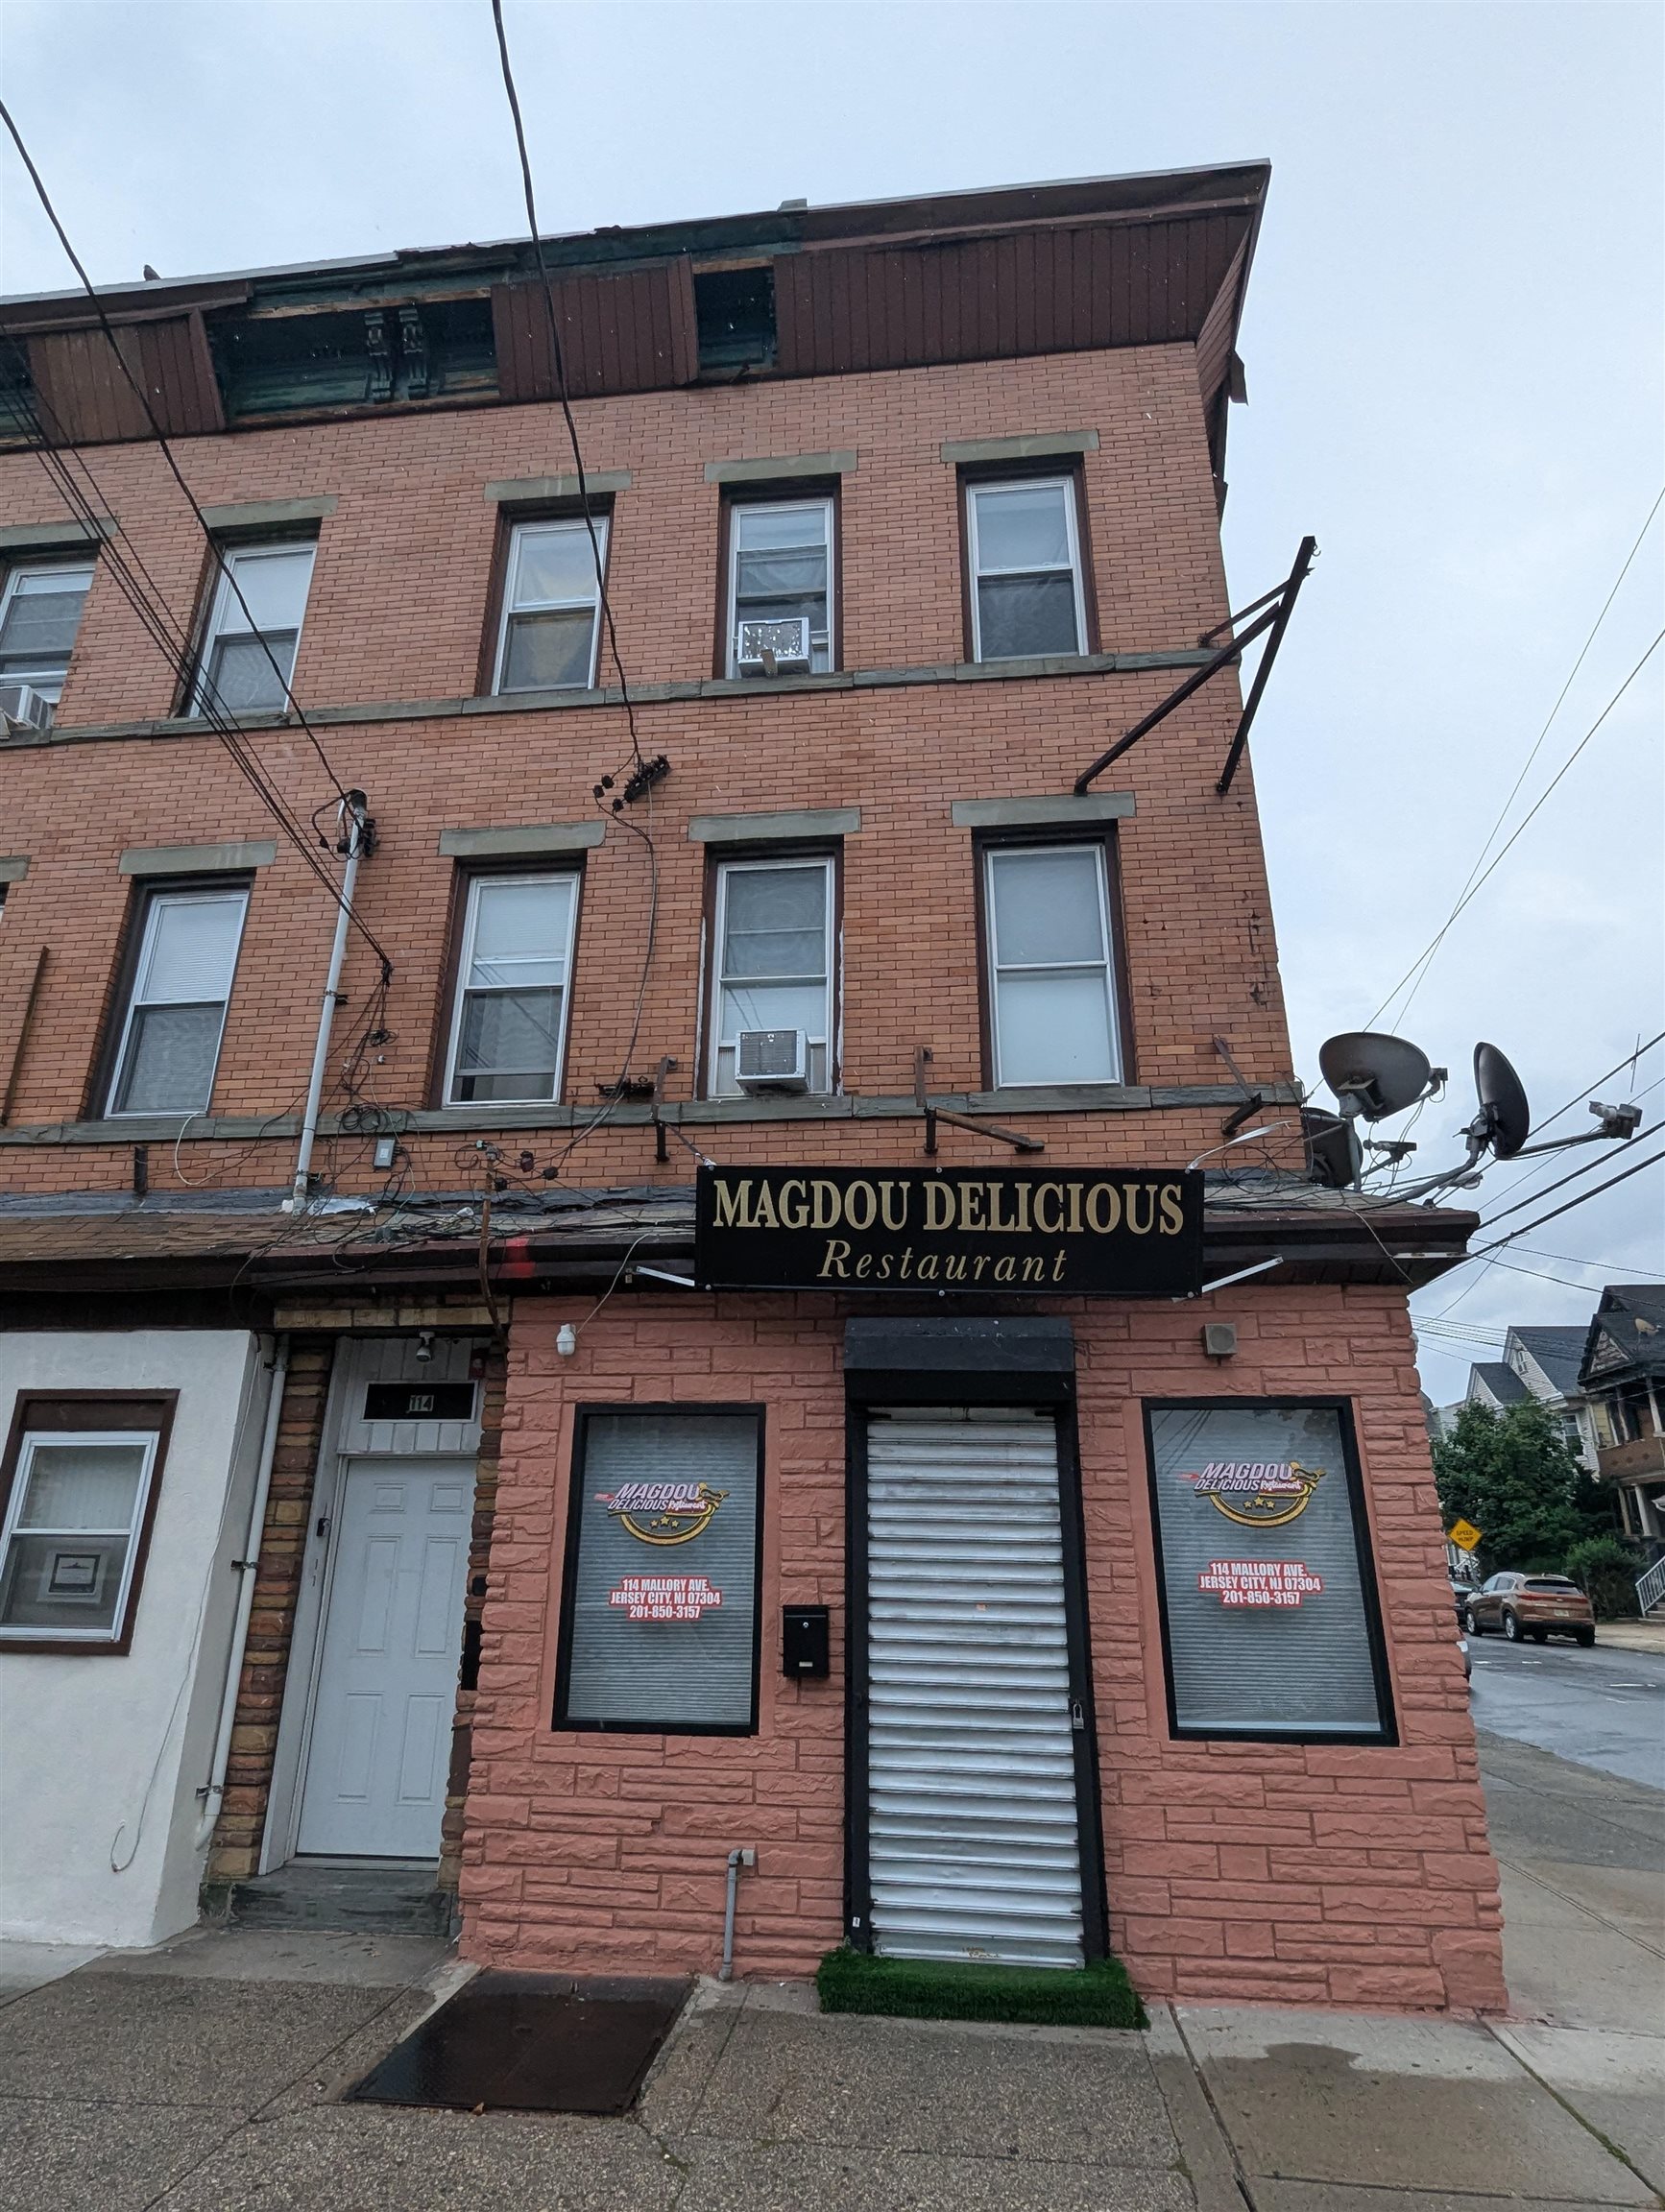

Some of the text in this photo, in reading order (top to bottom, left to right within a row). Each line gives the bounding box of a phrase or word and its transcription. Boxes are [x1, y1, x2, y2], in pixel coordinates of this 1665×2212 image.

[713, 1180, 1184, 1235] MAGDOU DELICIOUS
[816, 1238, 1067, 1282] Restaurant
[409, 1394, 434, 1411] 114
[1200, 1462, 1292, 1479] MAGDOU
[615, 1482, 701, 1500] MAGDOU
[1194, 1479, 1260, 1491] DELICIOUS
[607, 1499, 668, 1510] DELICIOUS
[1210, 1562, 1307, 1577] 114 MALLORY AVE.
[622, 1578, 710, 1592] 114 MALLORY AVE.
[1199, 1575, 1321, 1591] JERSEY CITY, NJ 07304
[611, 1592, 721, 1605] JERSEY CITY, NJ 07304
[1222, 1590, 1301, 1604] 201-850-3157
[630, 1605, 701, 1619] 201-850-3157
